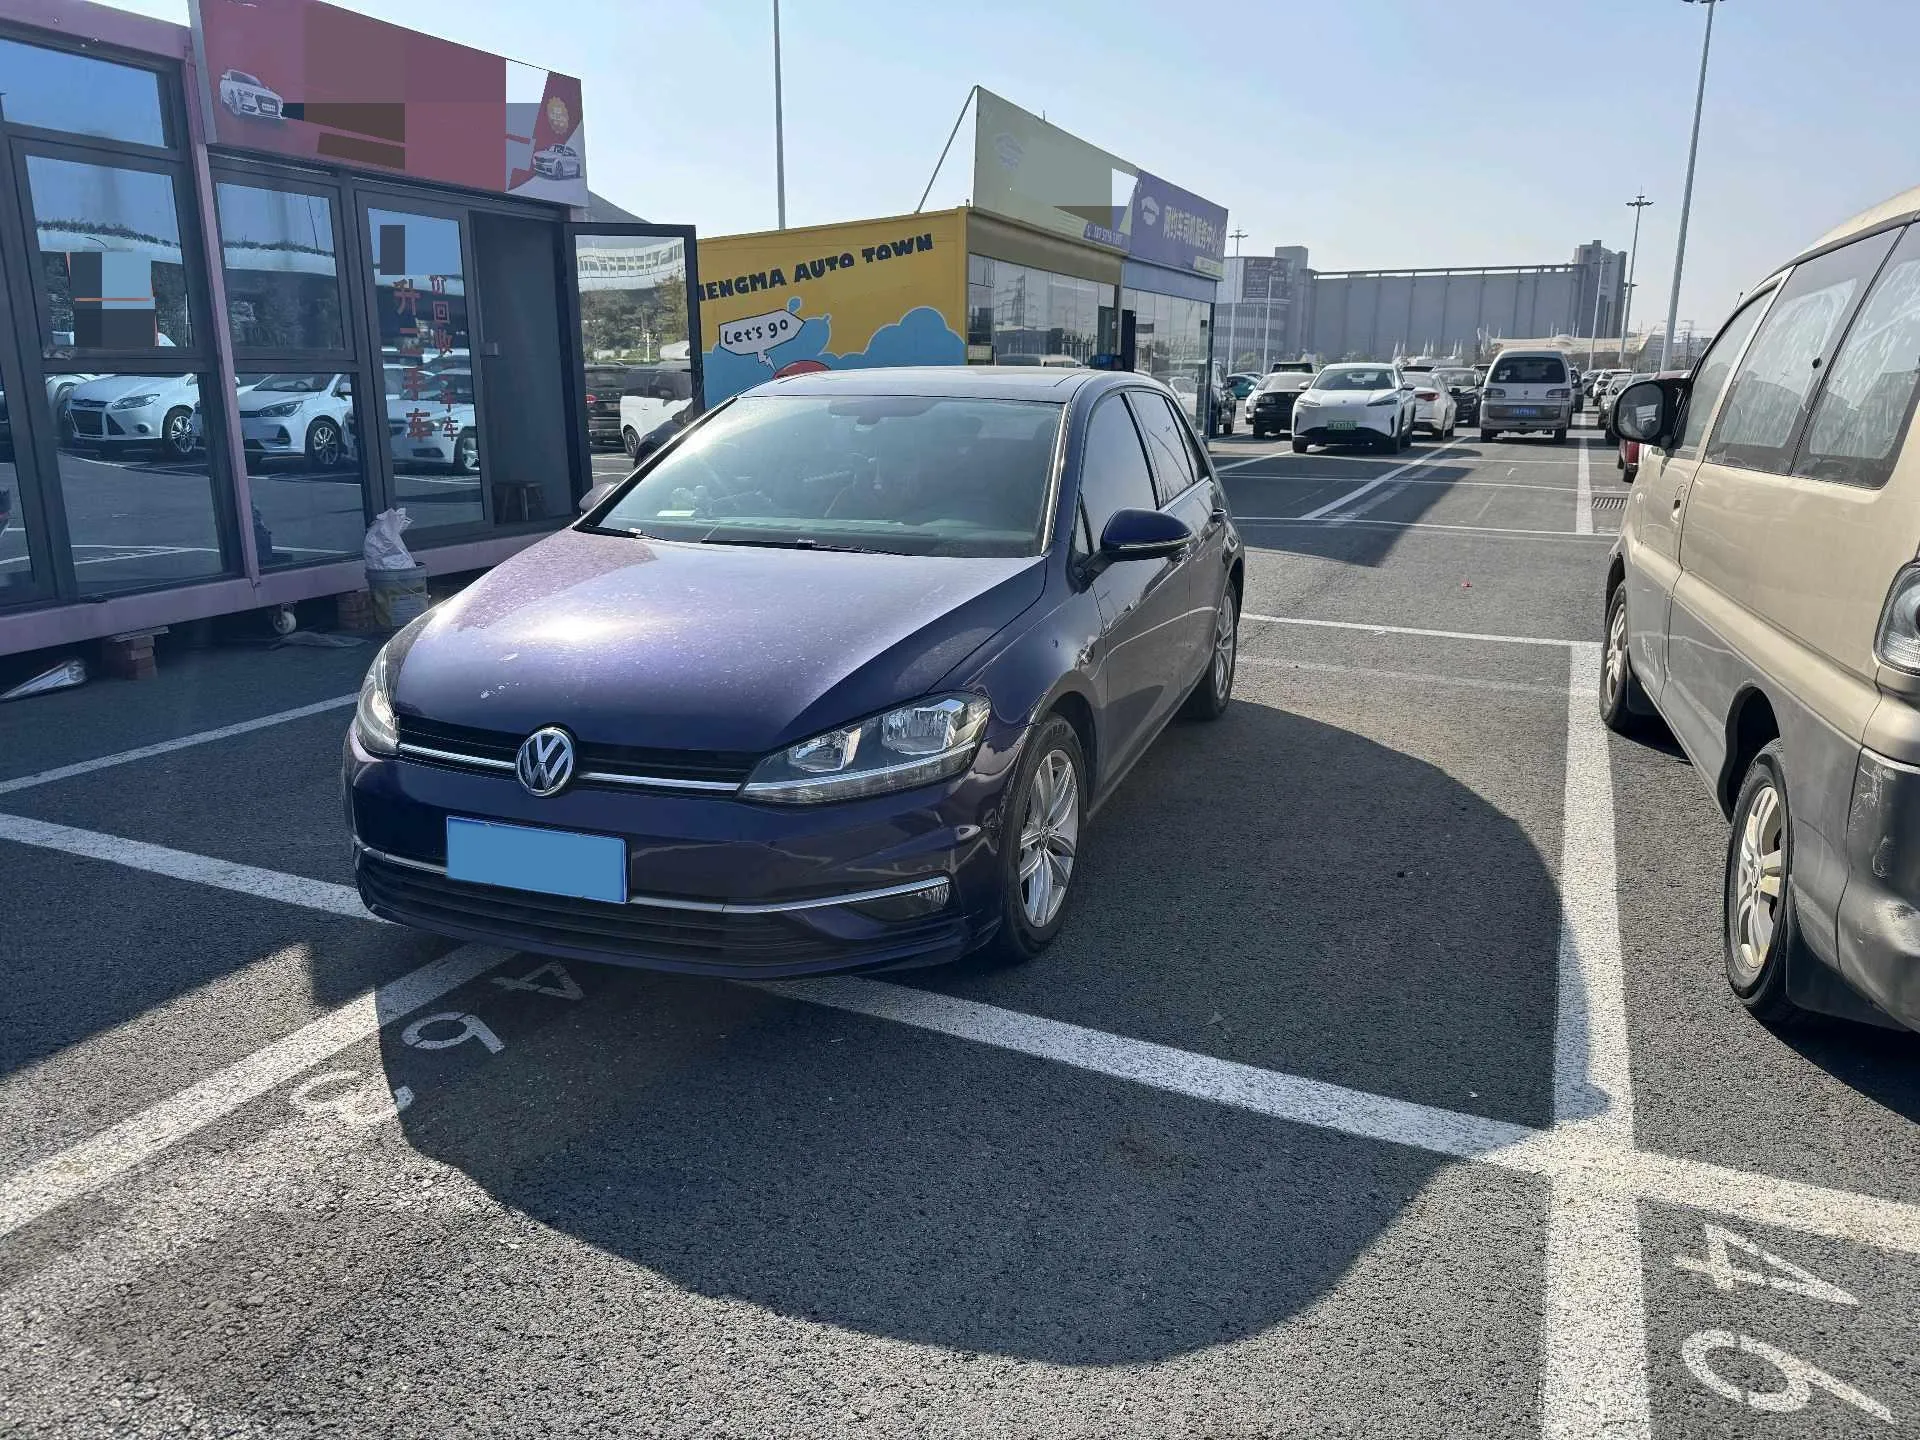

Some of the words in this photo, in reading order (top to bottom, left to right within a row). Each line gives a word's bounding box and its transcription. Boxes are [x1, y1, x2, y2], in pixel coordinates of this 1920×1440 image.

[794, 252, 855, 282] AUTO
[861, 232, 933, 263] TOWN
[725, 326, 763, 345] Let's
[768, 319, 788, 338] go
